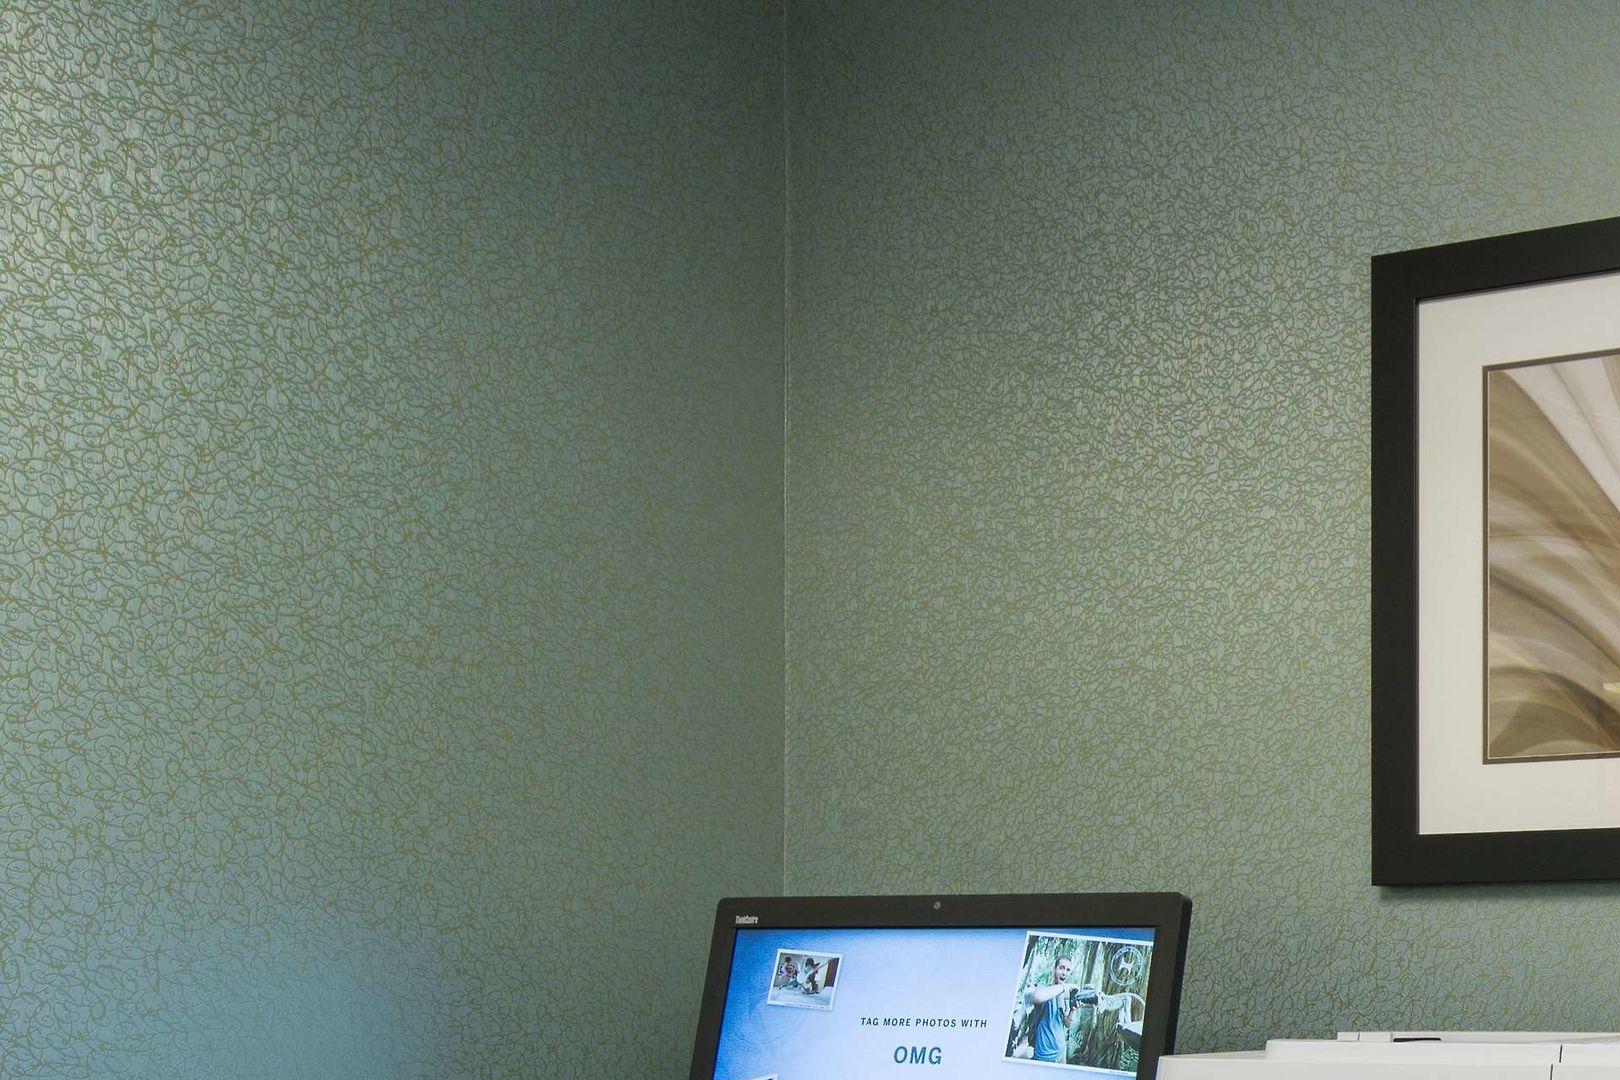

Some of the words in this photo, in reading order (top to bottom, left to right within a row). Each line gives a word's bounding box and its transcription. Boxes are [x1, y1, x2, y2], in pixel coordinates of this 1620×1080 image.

[861, 1017, 879, 1026] TAG
[883, 1018, 911, 1027] MORE
[916, 1018, 957, 1028] PHOTOS
[961, 1019, 988, 1028] WITH
[893, 1046, 942, 1065] OMG
